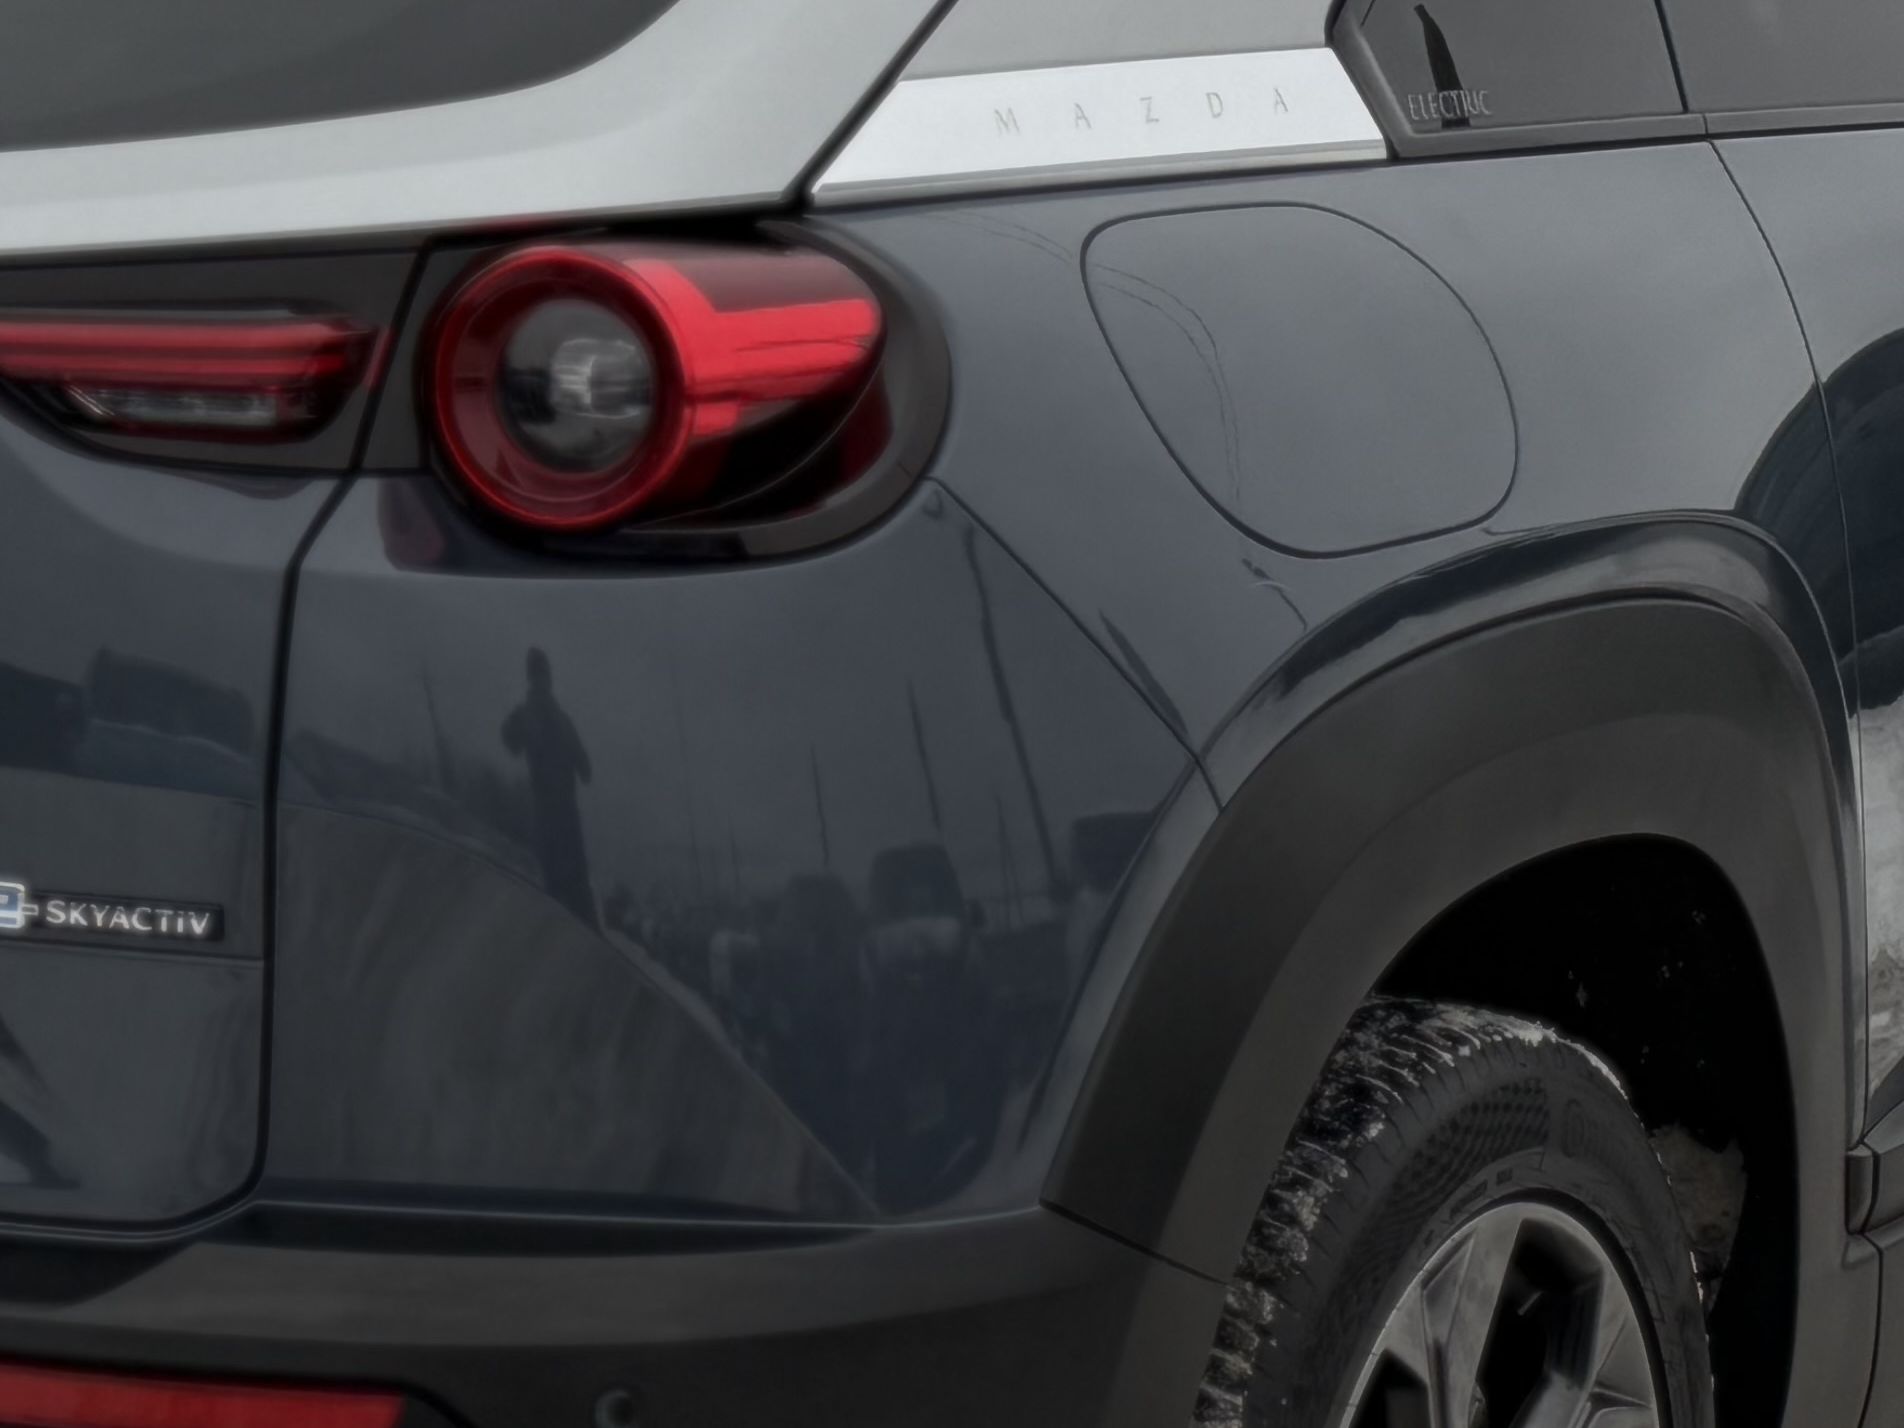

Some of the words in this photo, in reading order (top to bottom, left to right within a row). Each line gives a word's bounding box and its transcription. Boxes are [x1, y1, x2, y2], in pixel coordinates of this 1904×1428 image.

[994, 86, 1290, 136] MAZDA
[1408, 90, 1492, 120] ELECTRIC
[46, 899, 210, 934] SKYACTIV
